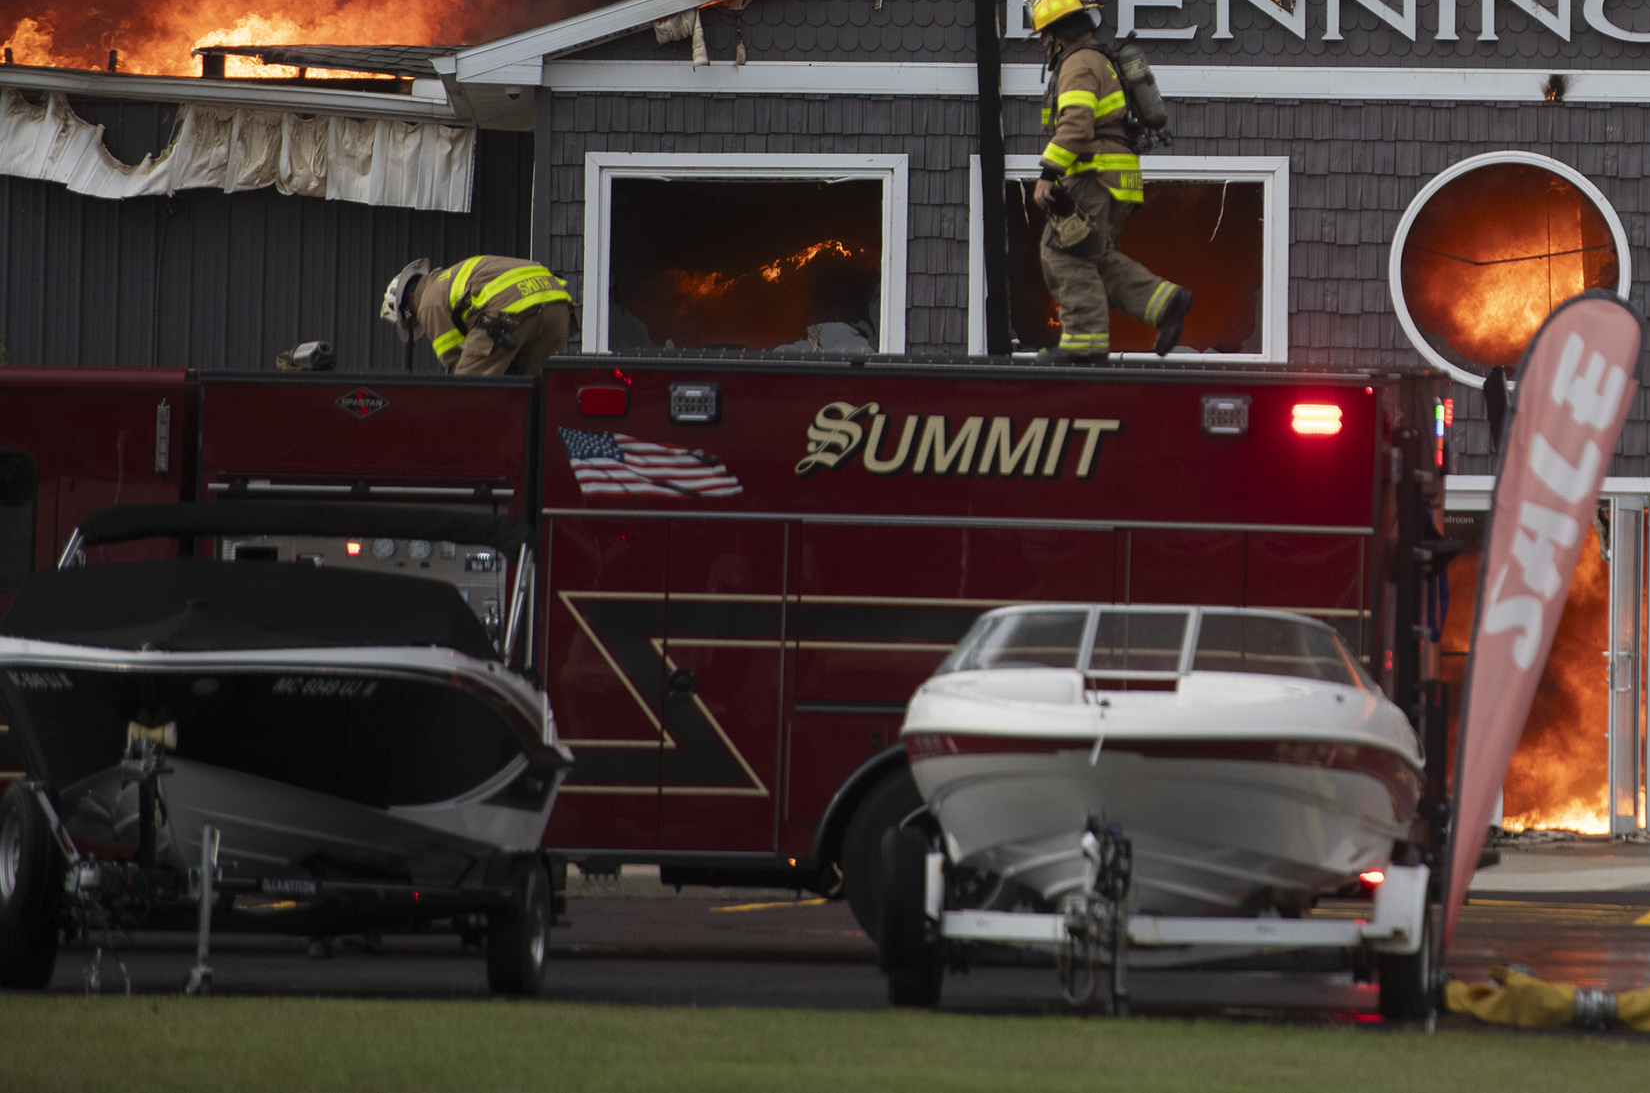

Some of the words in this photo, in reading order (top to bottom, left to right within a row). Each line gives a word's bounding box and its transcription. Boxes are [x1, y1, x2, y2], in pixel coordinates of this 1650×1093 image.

[517, 276, 552, 297] SMITH
[795, 401, 1123, 479] SUMMIT
[1485, 330, 1627, 671] SALE
